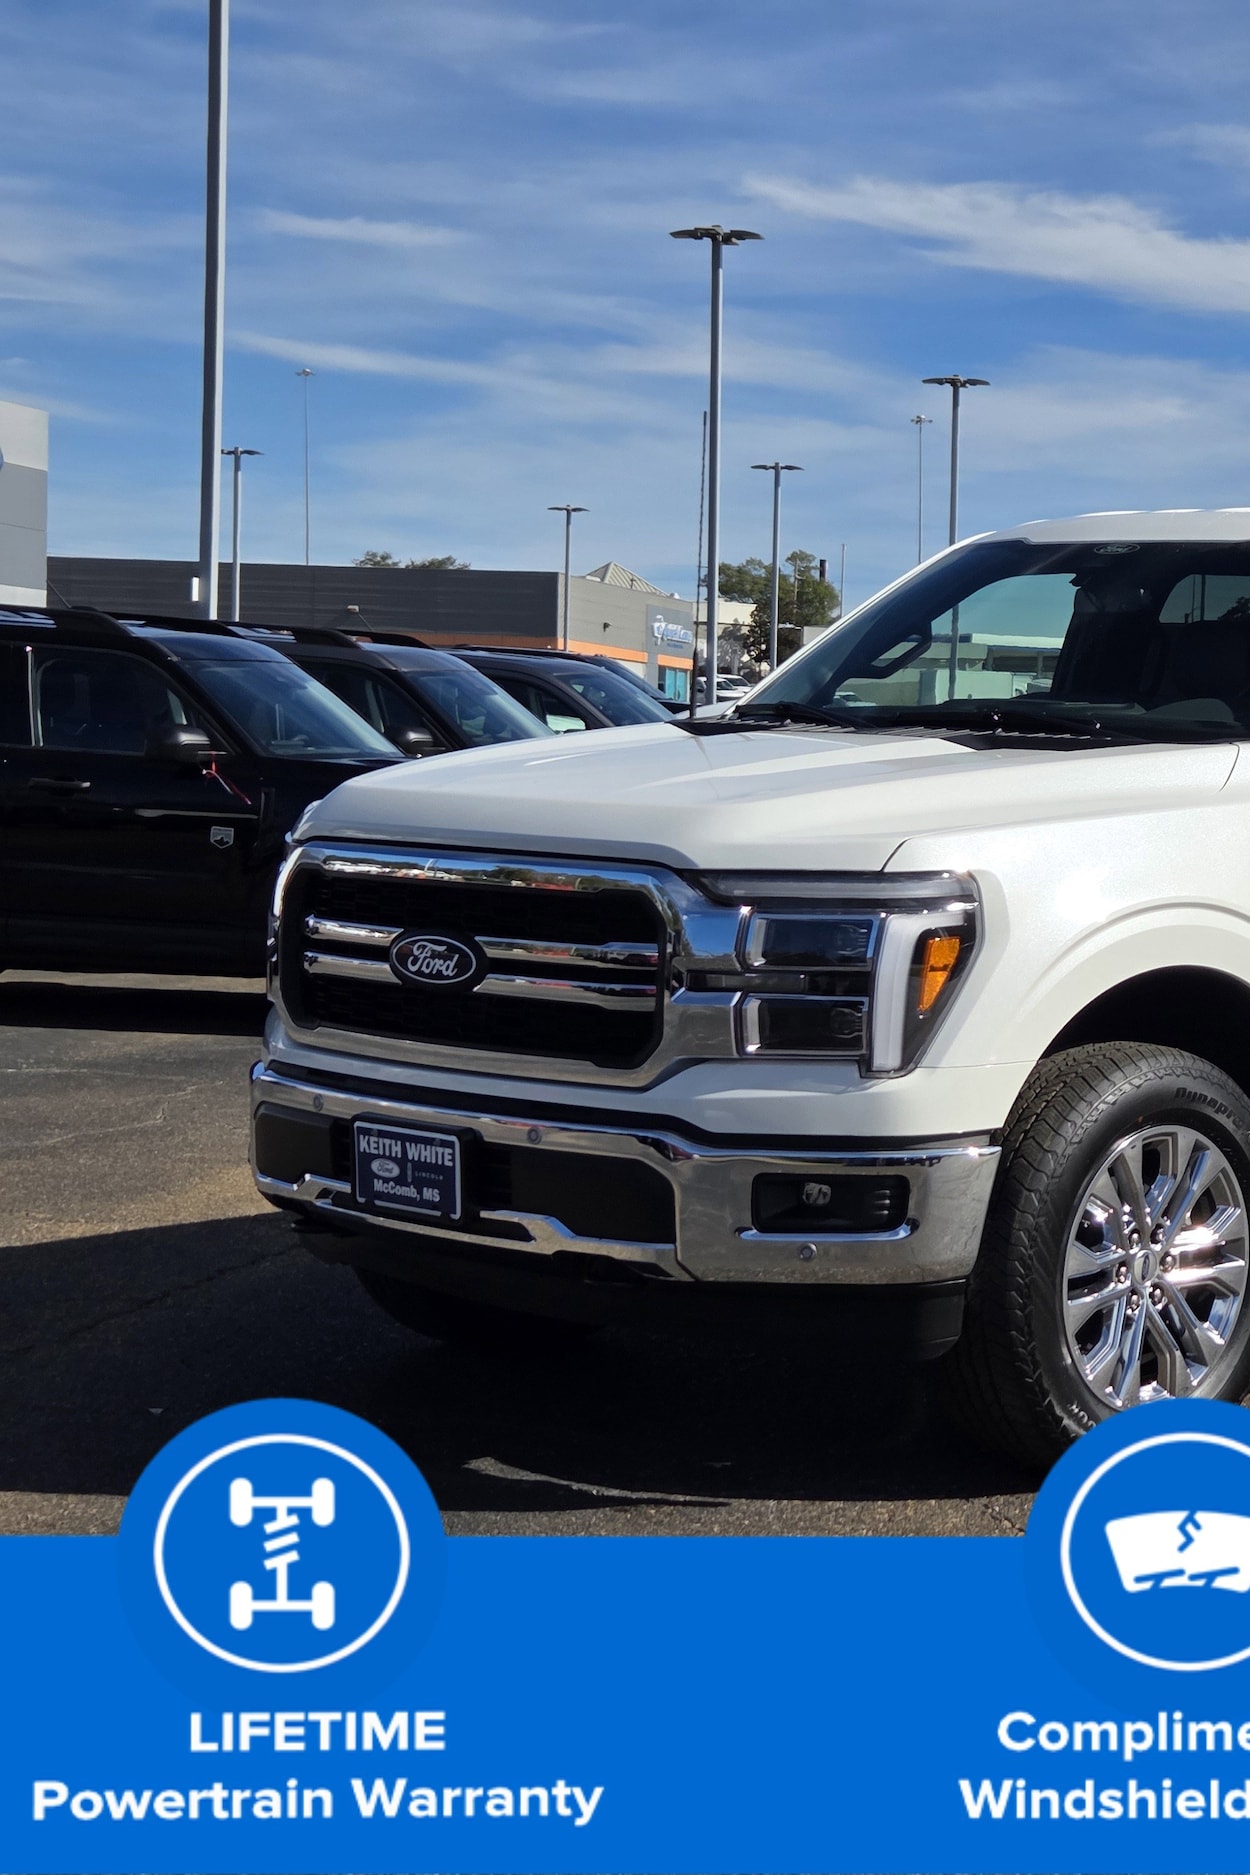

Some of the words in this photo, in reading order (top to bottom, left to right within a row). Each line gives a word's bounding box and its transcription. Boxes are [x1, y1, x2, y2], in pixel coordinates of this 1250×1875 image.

[407, 941, 459, 976] Ford
[360, 1134, 402, 1158] KEITH
[405, 1141, 454, 1167] WHITE
[415, 1171, 444, 1180] LINCOLN
[373, 1178, 420, 1201] McComb,
[422, 1186, 441, 1202] MS
